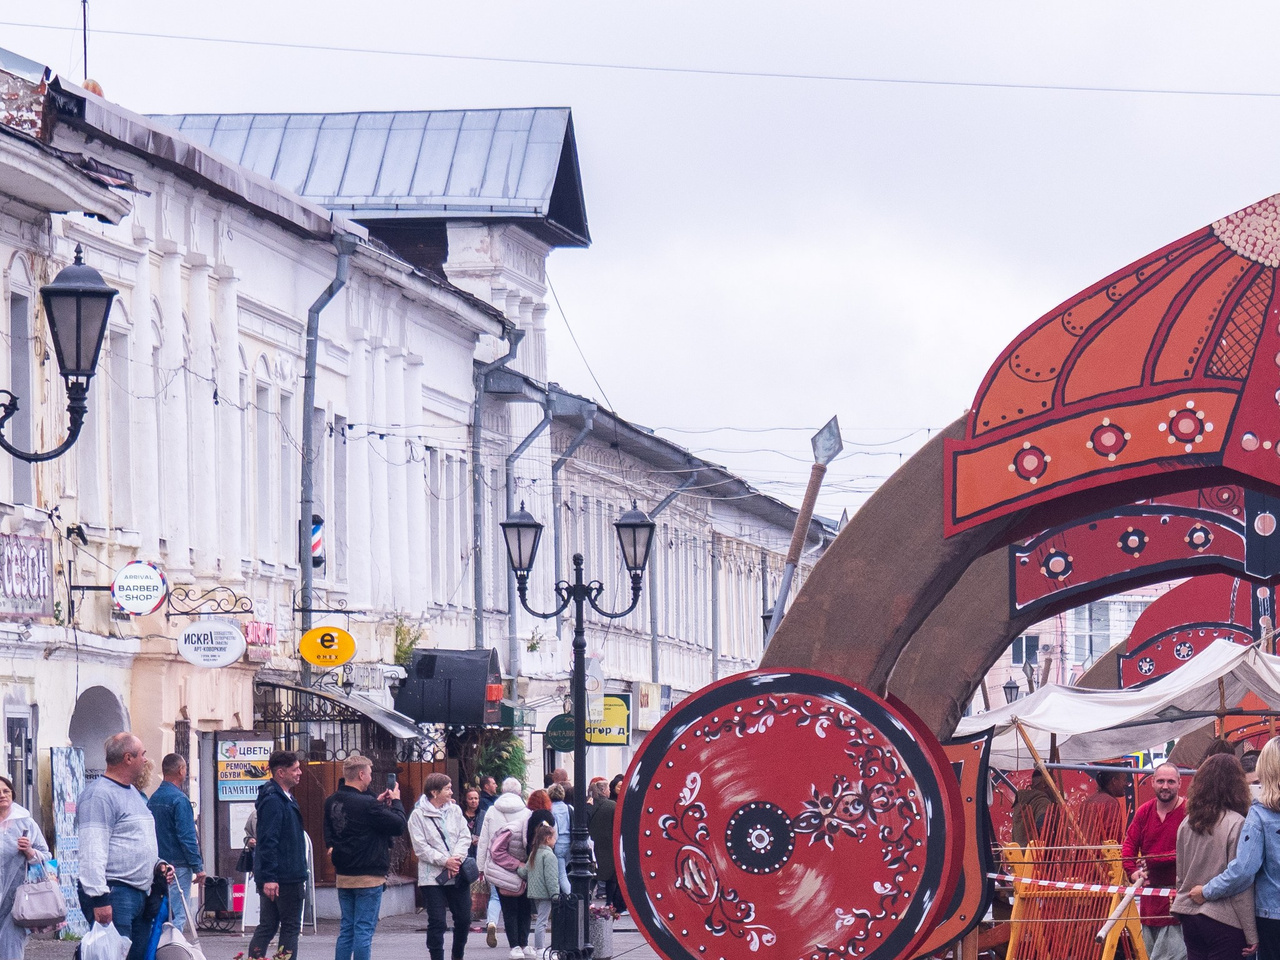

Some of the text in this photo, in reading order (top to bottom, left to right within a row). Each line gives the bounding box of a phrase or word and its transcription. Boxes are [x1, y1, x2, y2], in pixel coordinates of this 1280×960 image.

[239, 747, 271, 757] ЦВЕТЫ
[226, 763, 251, 771] РЕМОНТ
[220, 771, 241, 779] ОБУВИ
